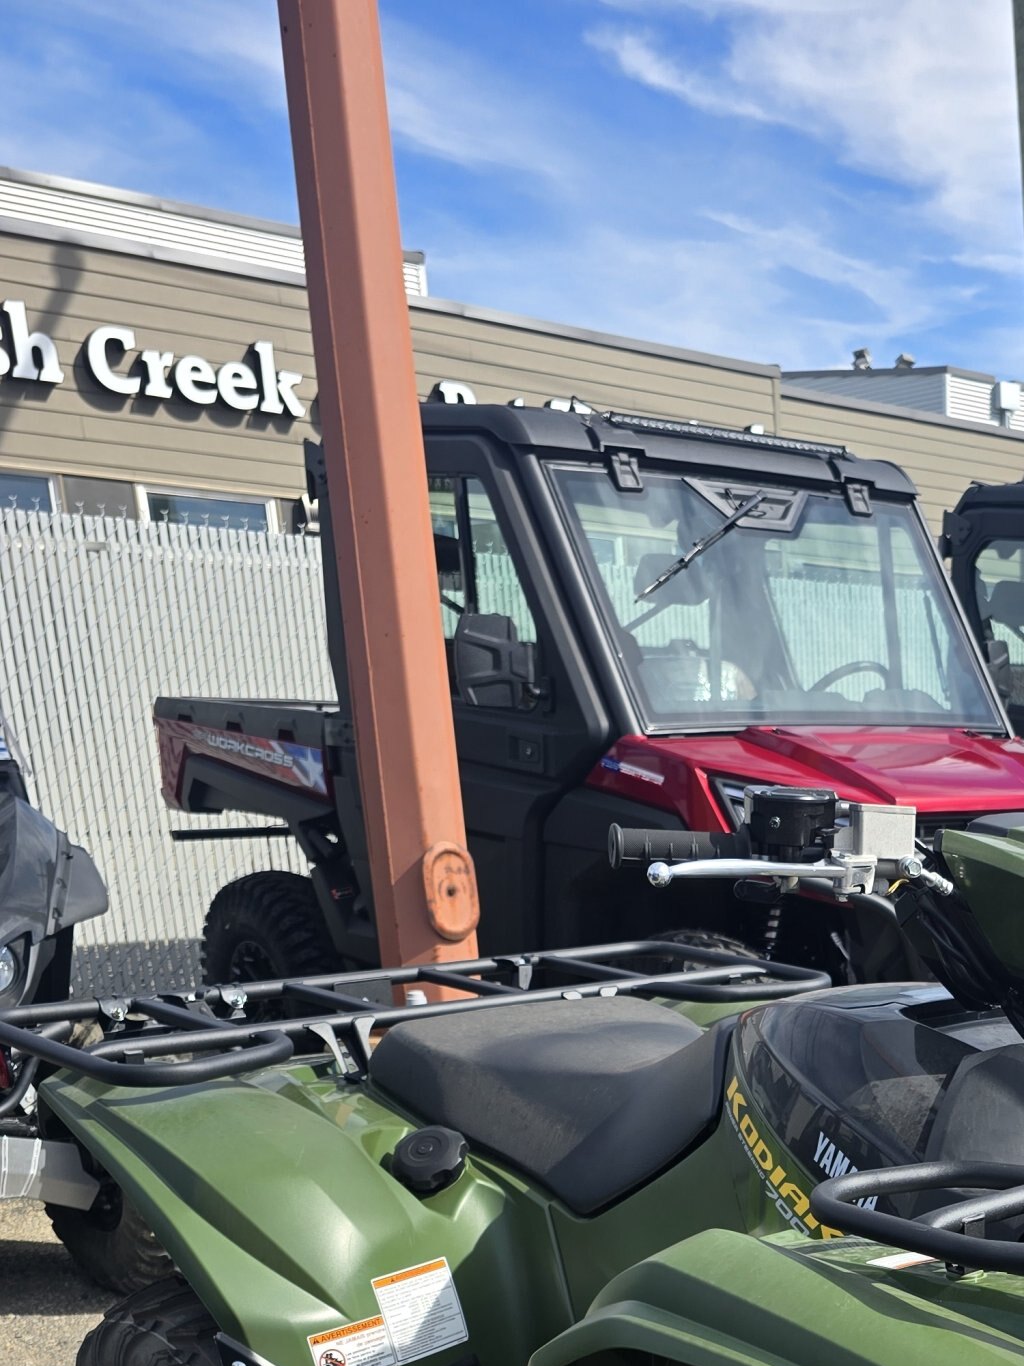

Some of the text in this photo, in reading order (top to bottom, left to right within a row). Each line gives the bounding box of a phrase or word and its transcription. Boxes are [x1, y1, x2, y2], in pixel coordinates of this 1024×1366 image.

[88, 326, 306, 417] Creek
[207, 735, 294, 767] WORKCROSS
[726, 1076, 845, 1242] KODIAK
[813, 1131, 879, 1212] YAMA
[765, 1180, 810, 1236] 700
[321, 1318, 381, 1342] AVERTISSEMENT
